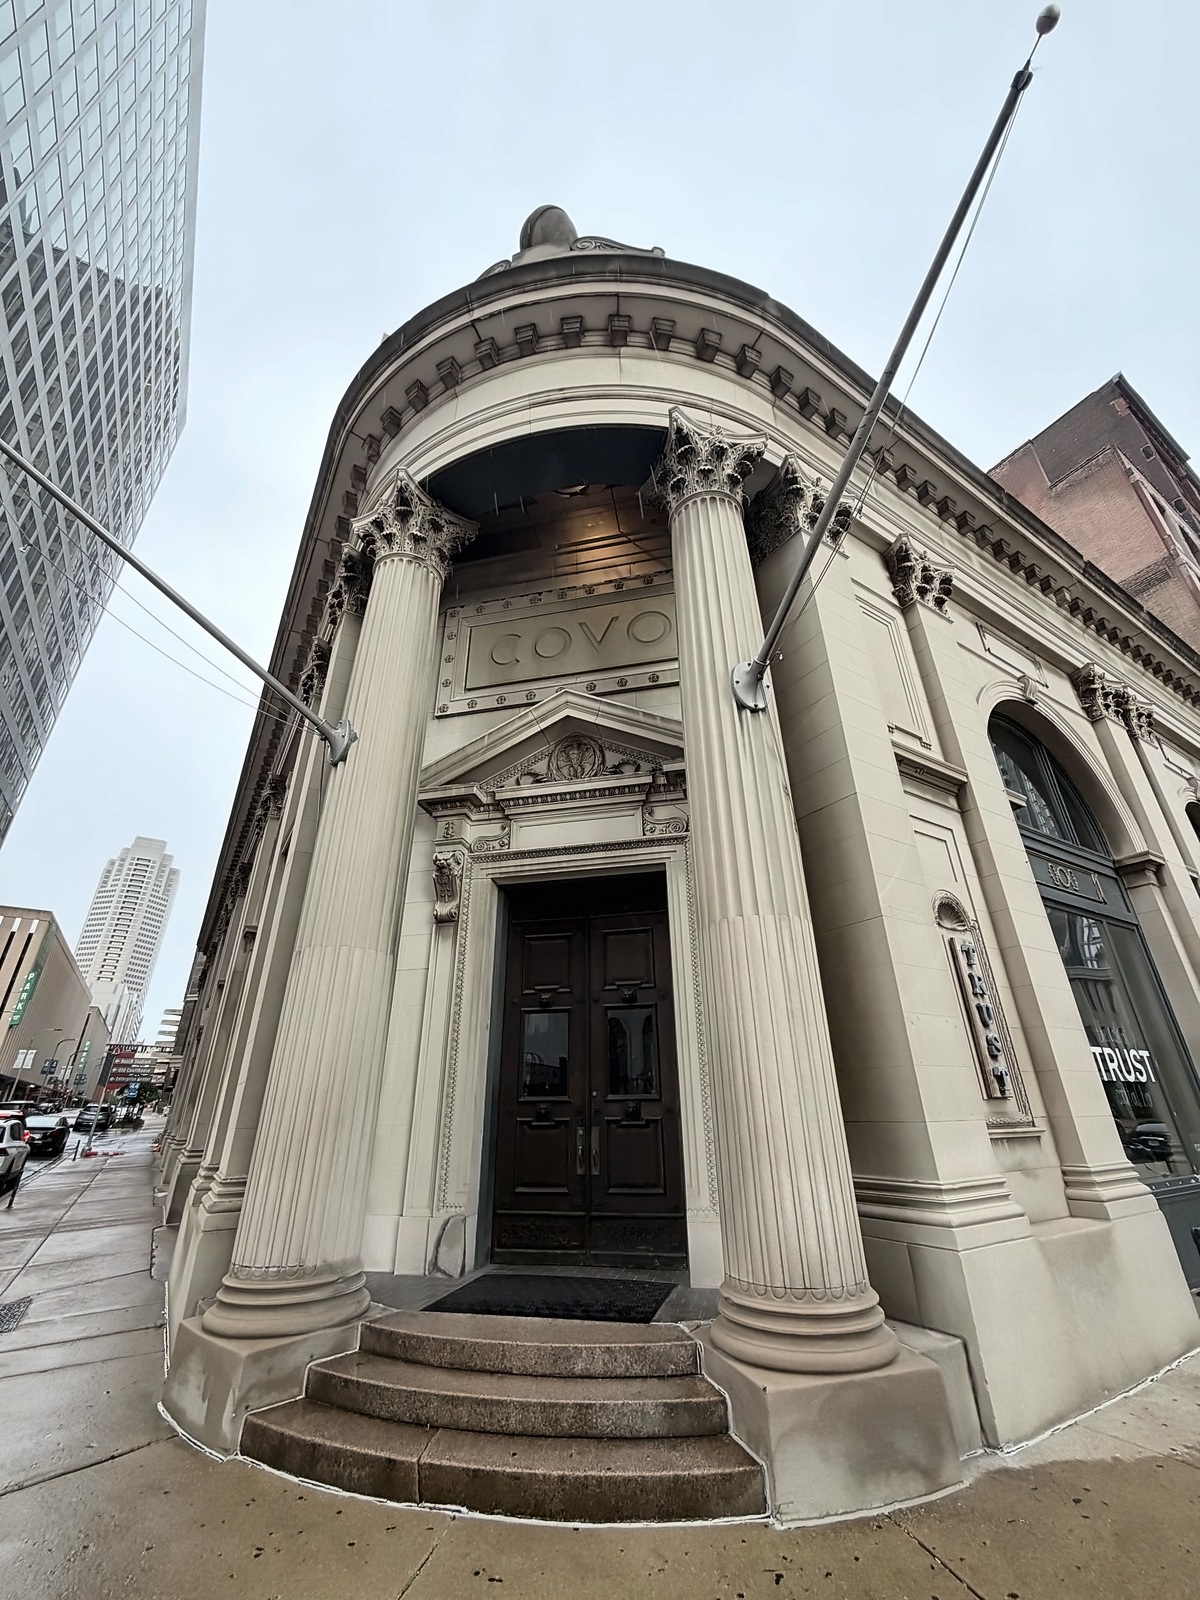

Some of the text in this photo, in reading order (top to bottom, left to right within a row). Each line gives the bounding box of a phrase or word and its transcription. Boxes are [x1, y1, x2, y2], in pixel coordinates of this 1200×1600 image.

[491, 610, 672, 666] COVO
[17, 973, 35, 1010] PARK
[961, 942, 1010, 1095] TRUST
[1090, 1046, 1156, 1083] TRUST
